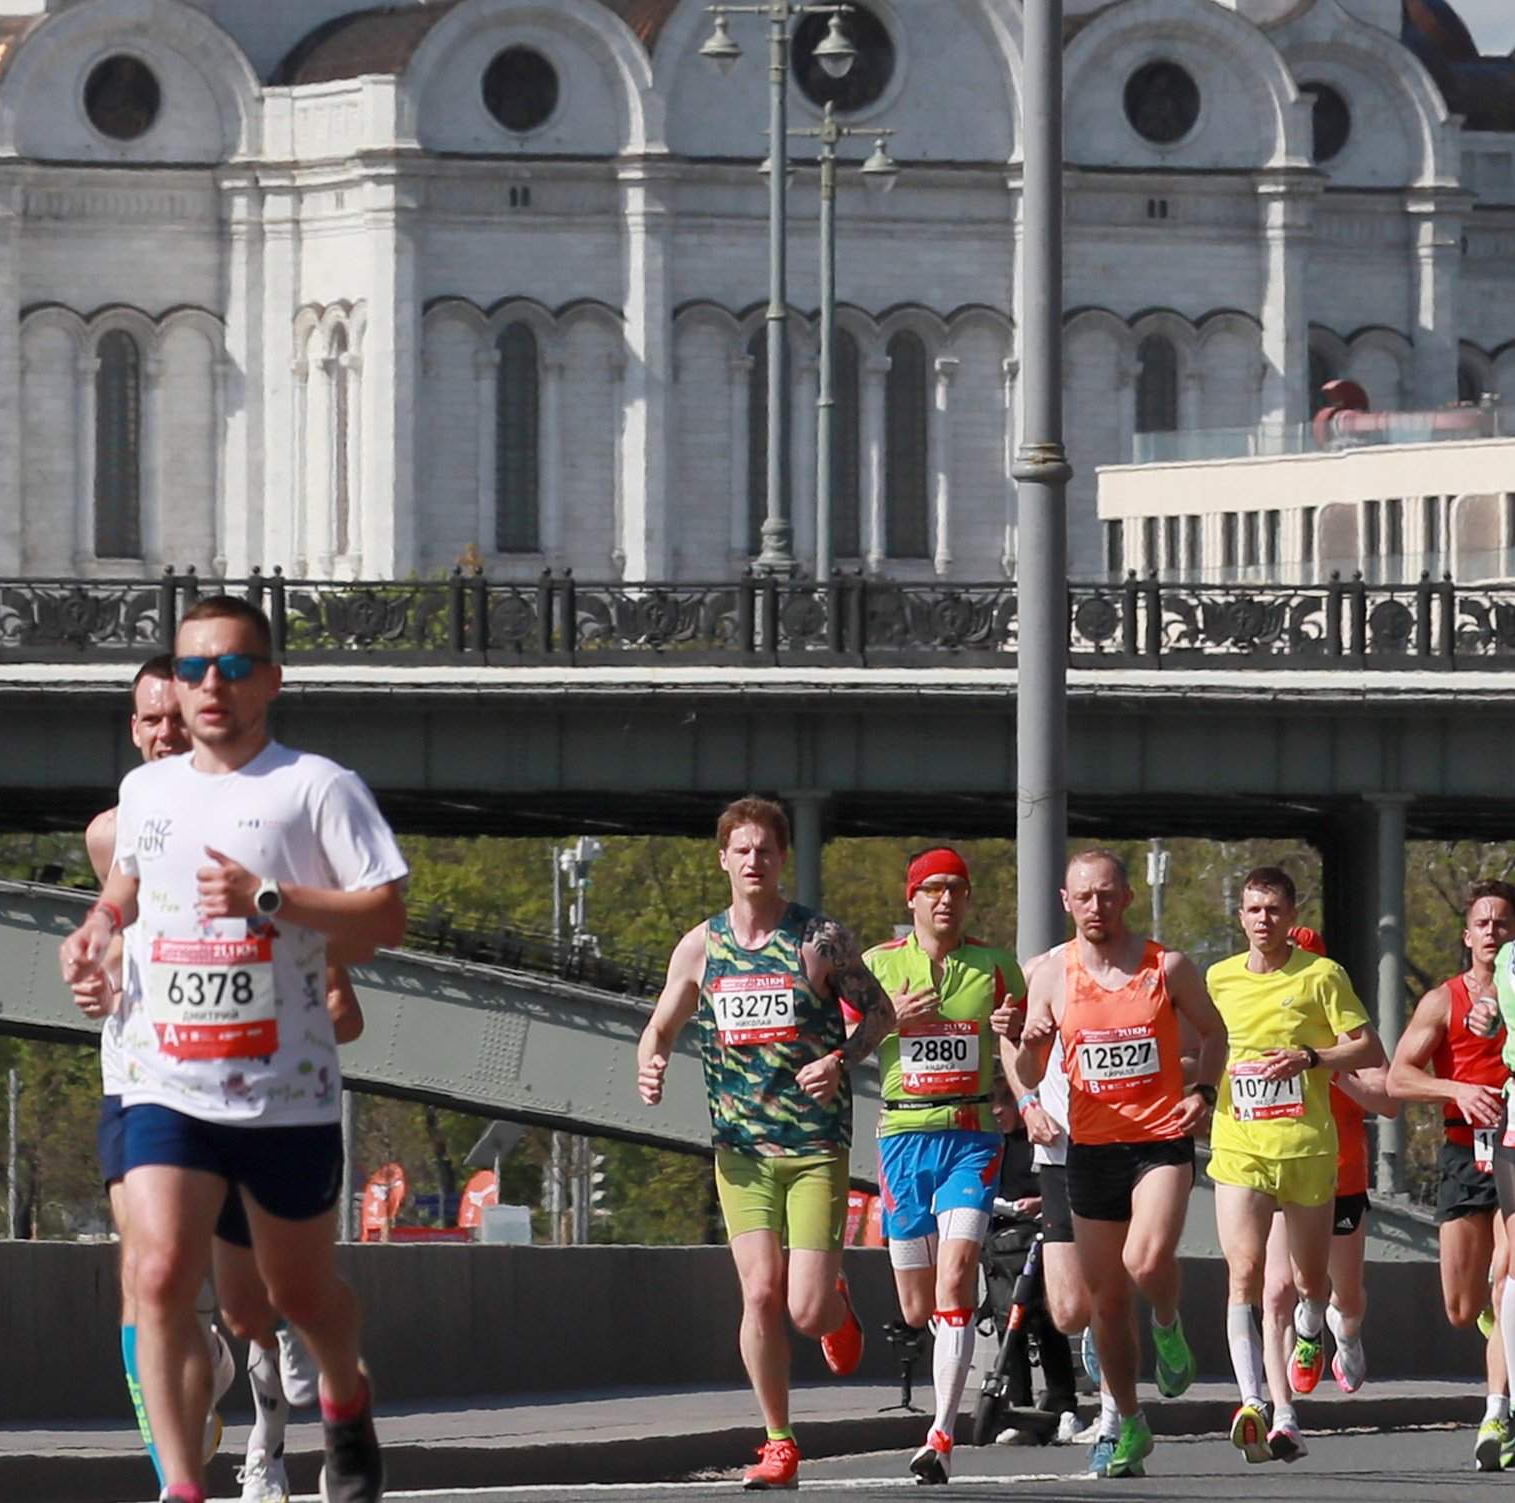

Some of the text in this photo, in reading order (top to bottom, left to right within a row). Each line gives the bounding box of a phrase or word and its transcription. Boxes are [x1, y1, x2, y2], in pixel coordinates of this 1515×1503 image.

[168, 971, 254, 1006] 6378
[718, 994, 789, 1019] 13275
[911, 1039, 967, 1062] 2880
[1082, 1042, 1152, 1070] 12527
